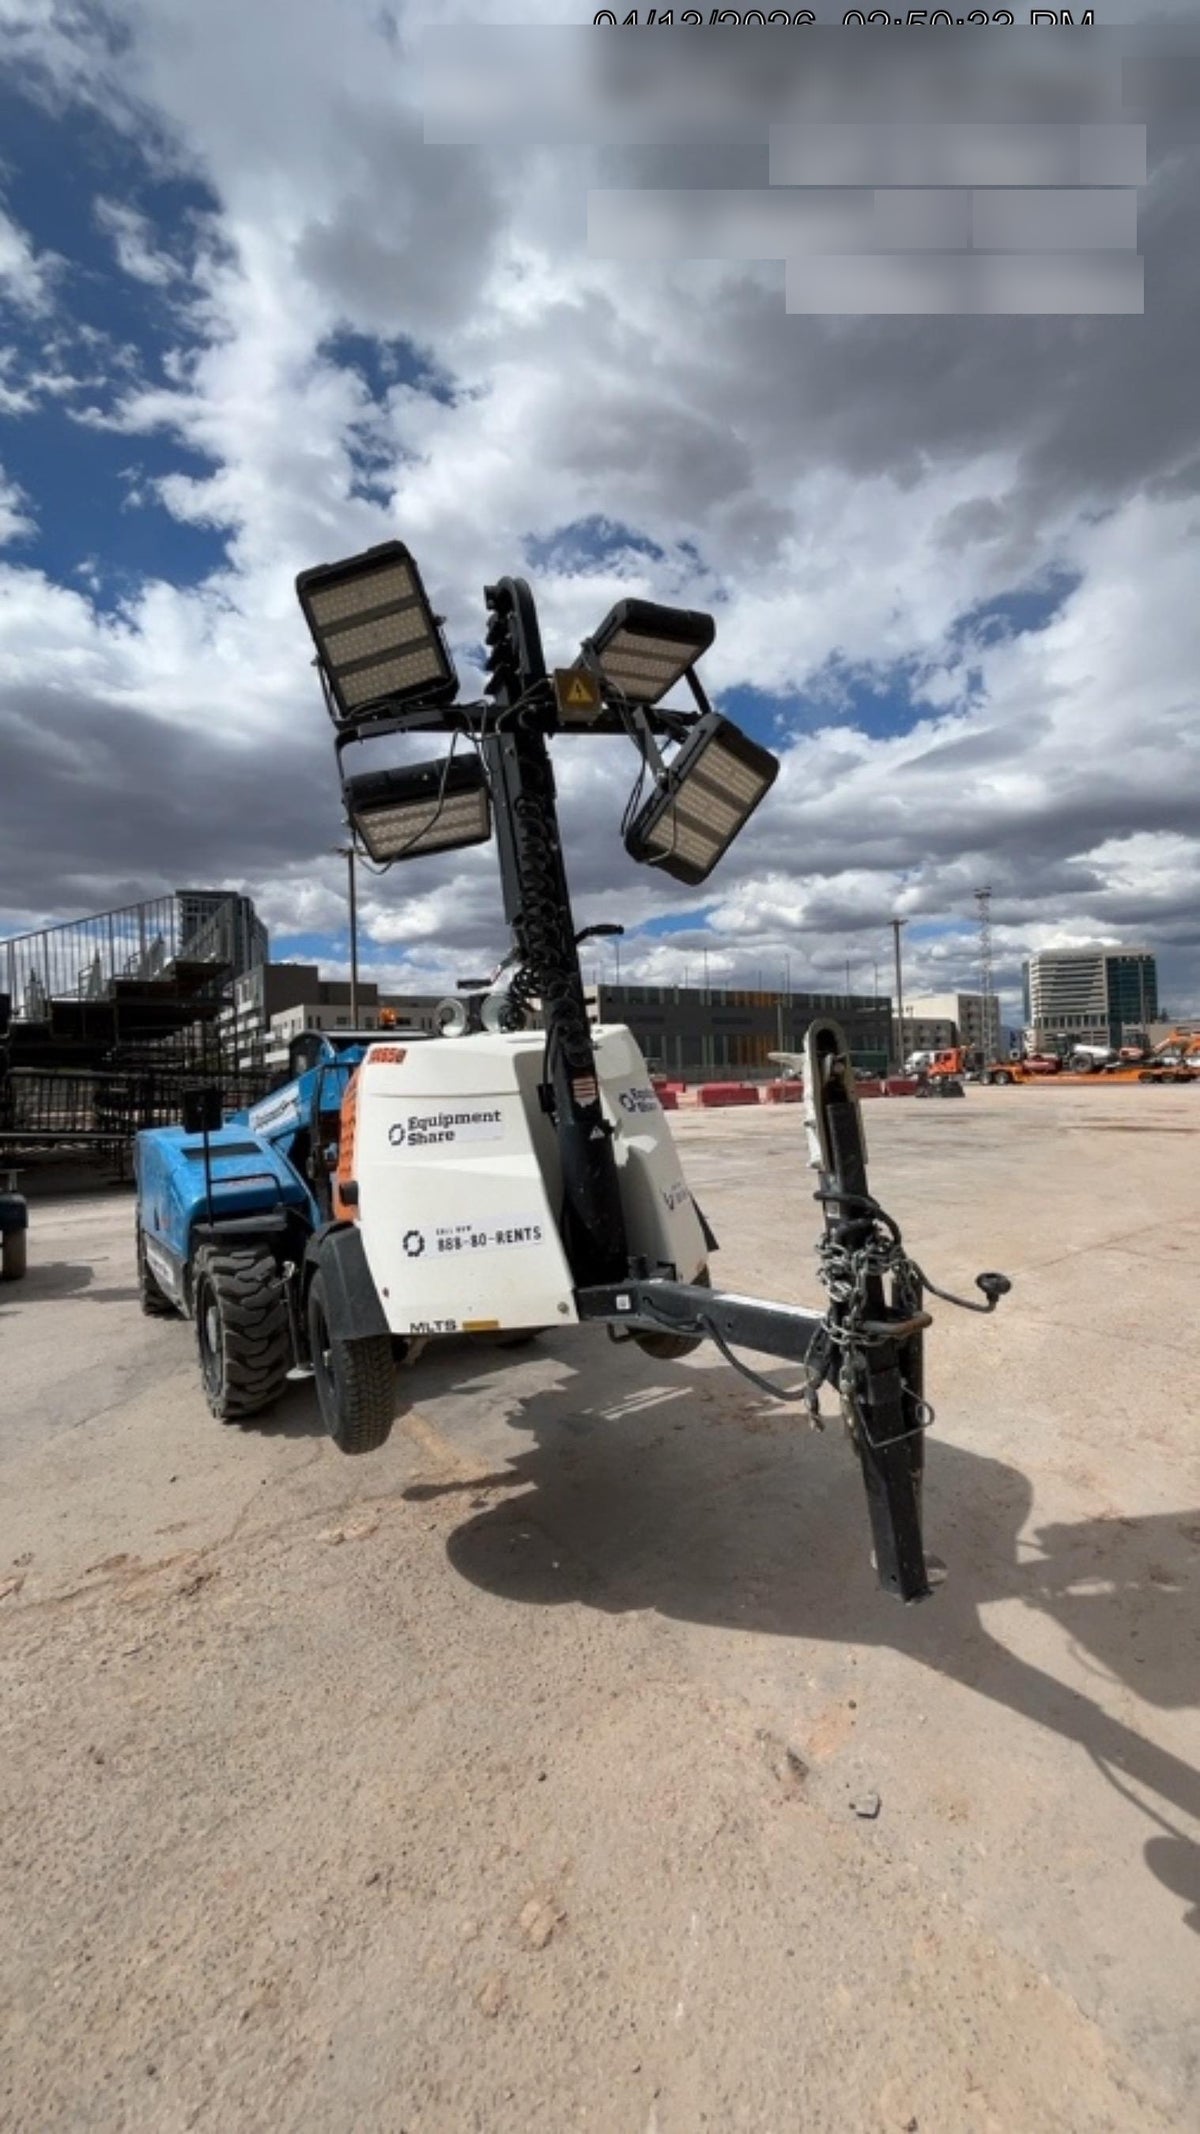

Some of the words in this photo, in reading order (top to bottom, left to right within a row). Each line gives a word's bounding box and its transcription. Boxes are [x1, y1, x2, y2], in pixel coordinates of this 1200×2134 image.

[407, 1109, 501, 1131] Equipment
[407, 1130, 456, 1146] Share
[438, 1225, 542, 1252] 888-80-RENTS
